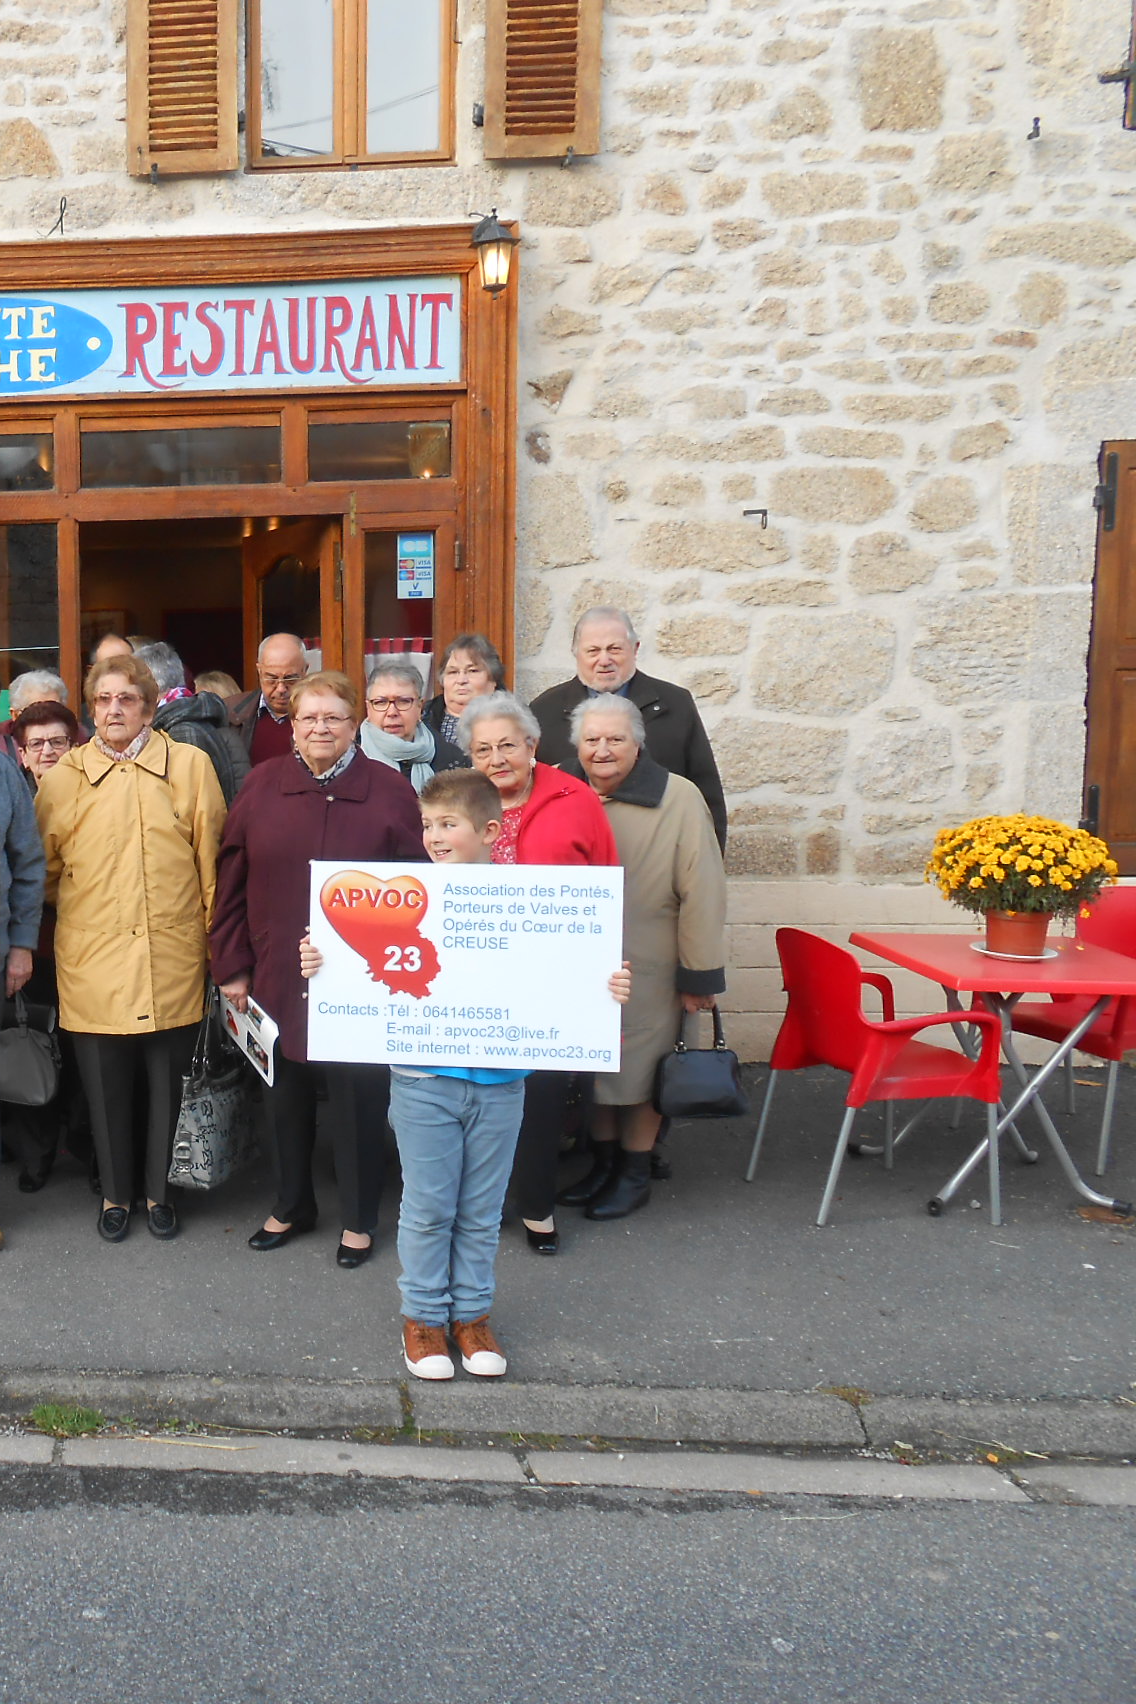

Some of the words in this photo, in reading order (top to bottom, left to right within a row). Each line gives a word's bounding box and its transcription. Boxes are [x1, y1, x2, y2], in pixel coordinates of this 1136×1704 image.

[116, 293, 453, 391] RESTAURANT
[327, 888, 424, 910] APVOC
[443, 883, 525, 896] Association
[529, 885, 555, 897] des
[560, 885, 614, 899] Pontés,
[443, 901, 503, 914] Porteurs
[507, 902, 525, 914] de
[530, 902, 578, 915] Valves
[583, 904, 596, 916] et
[443, 918, 495, 933] Opérés
[499, 919, 517, 932] du
[522, 920, 563, 933] Cœur
[567, 921, 585, 934] de
[590, 921, 602, 934] la
[443, 936, 509, 950] CREUSE
[383, 945, 422, 972] 23
[318, 1002, 379, 1017] Contacts
[422, 1005, 510, 1020] 0641465581
[386, 1022, 431, 1036] E-mail
[444, 1025, 560, 1042] apvoc23@live.fr
[386, 1039, 412, 1053] Site
[417, 1040, 471, 1055] internet
[484, 1044, 611, 1062] www.apvoc23.org
